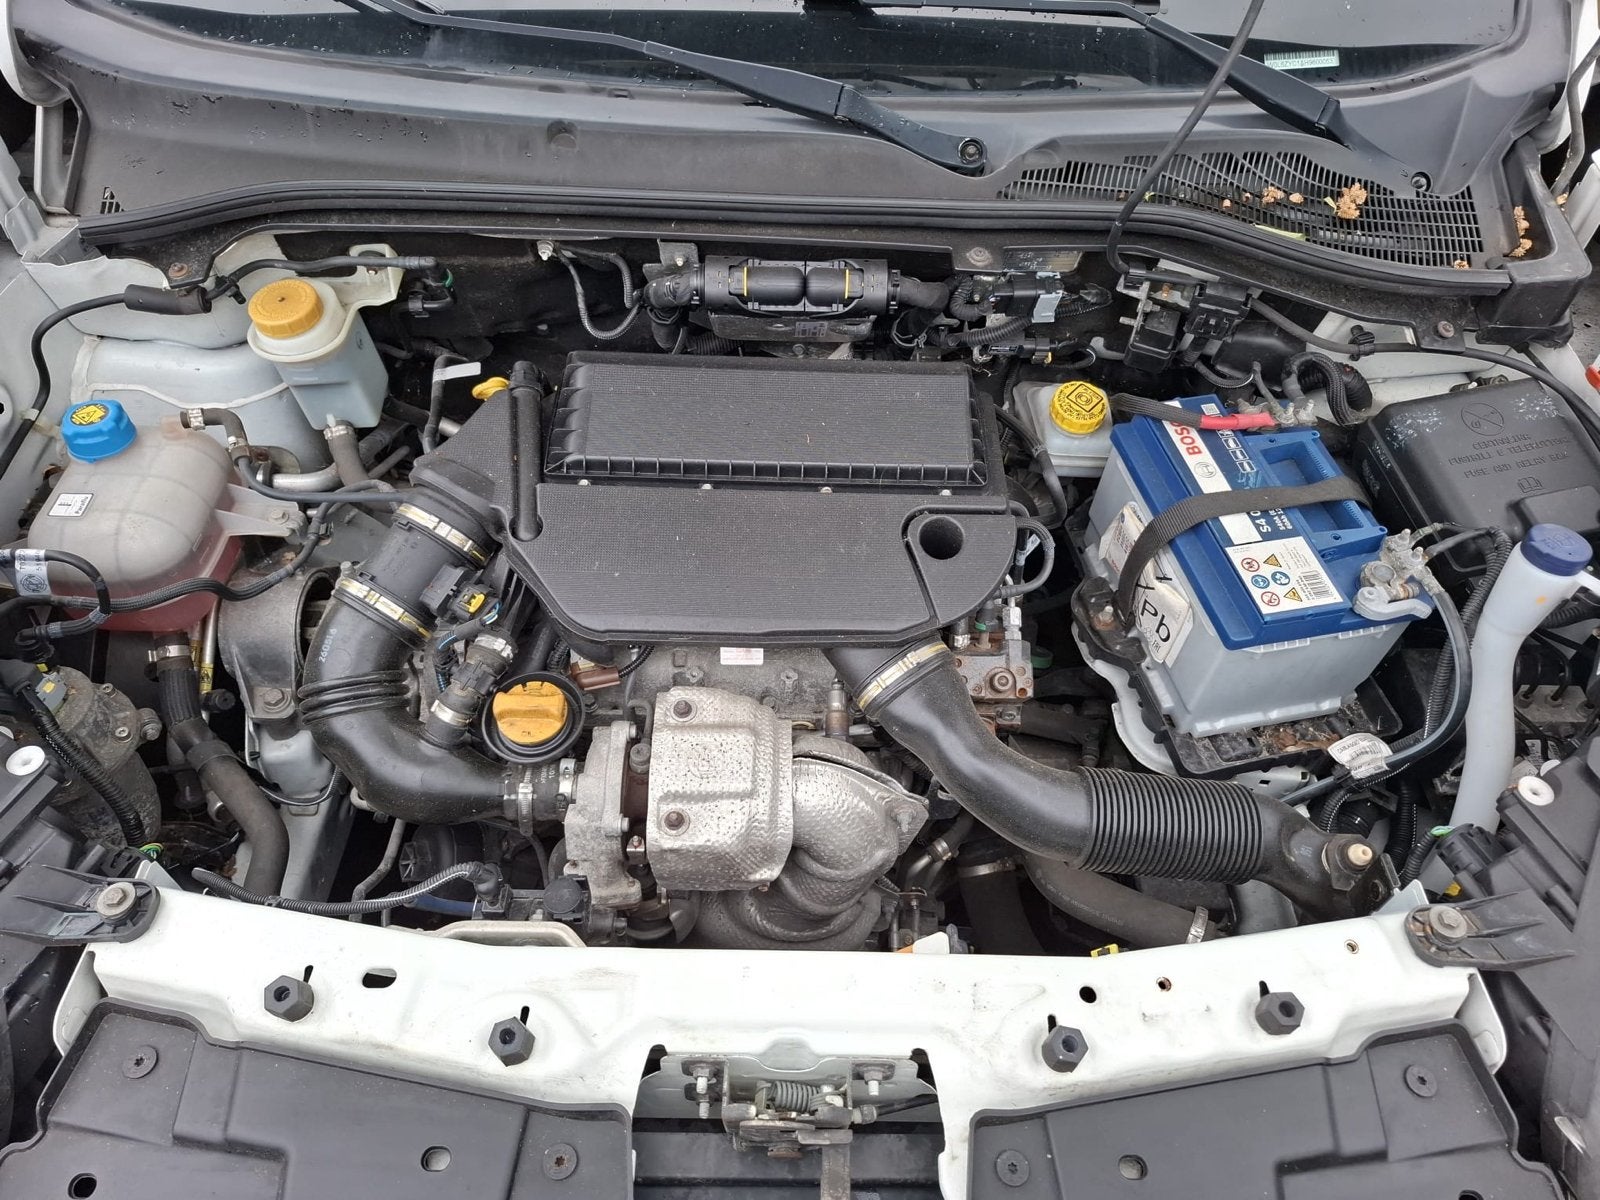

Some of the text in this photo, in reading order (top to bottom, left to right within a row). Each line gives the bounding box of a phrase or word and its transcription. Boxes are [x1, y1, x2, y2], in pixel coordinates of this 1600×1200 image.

[1464, 465, 1490, 479] FUSE
[1255, 518, 1271, 533] S4
[1140, 599, 1170, 643] Pb
